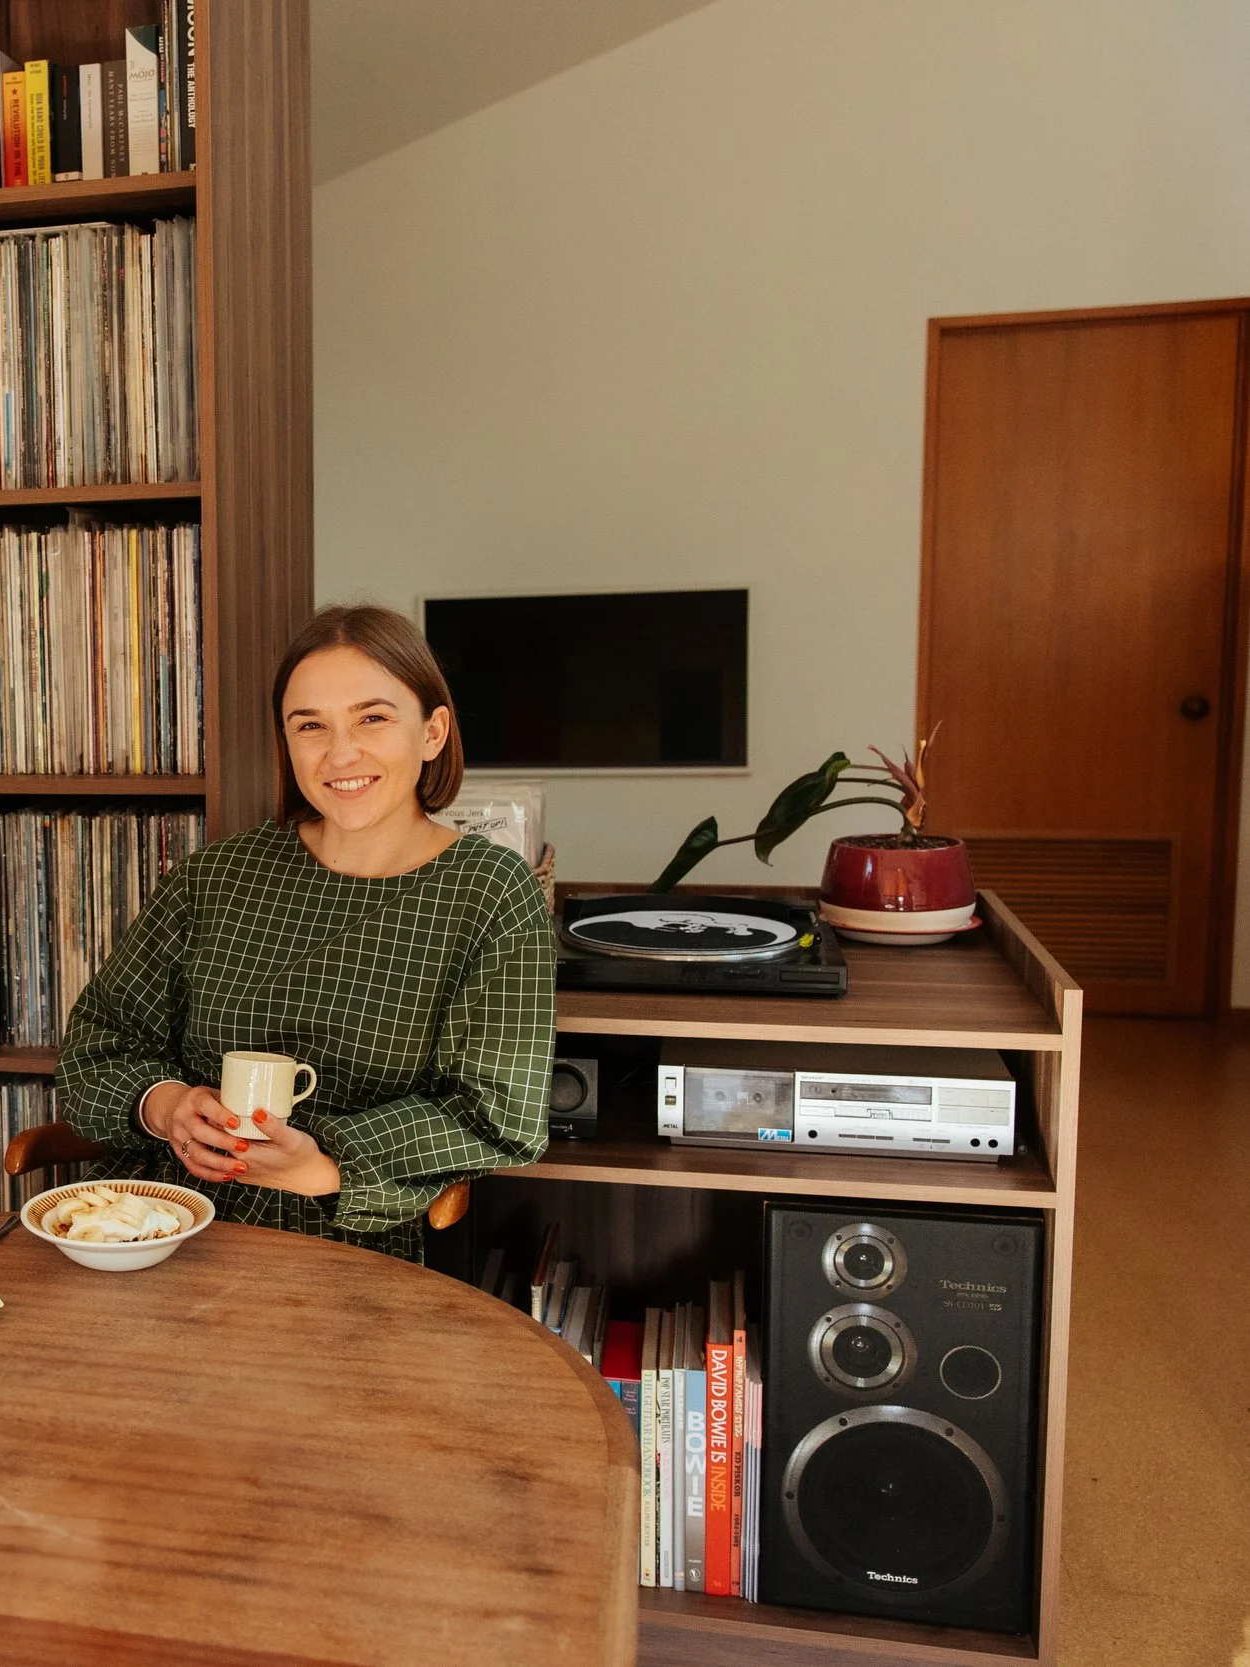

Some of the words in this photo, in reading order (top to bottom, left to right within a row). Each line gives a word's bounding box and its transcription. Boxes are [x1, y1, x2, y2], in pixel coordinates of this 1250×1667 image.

[128, 69, 155, 79] MOJO
[187, 62, 196, 79] THE
[108, 99, 116, 127] YEARS
[187, 81, 196, 129] ANTHOLOGY
[13, 99, 22, 148] REVOLUTION
[36, 125, 45, 144] COULD
[117, 110, 125, 162] McCARTNEY
[466, 808, 485, 817] Jerk
[939, 1279, 1008, 1293] Technics
[643, 1373, 653, 1394] THE
[660, 1377, 671, 1391] POP
[711, 1349, 727, 1397] DAVID
[661, 1392, 671, 1408] STAR
[643, 1396, 653, 1435] GUITAR
[661, 1408, 671, 1444] PORTRAITS
[711, 1399, 727, 1448] BOWIE
[642, 1437, 653, 1497] HANDBOOK
[685, 1410, 706, 1517] BOWIE
[710, 1450, 727, 1463] IS
[734, 1451, 741, 1463] ED
[710, 1466, 726, 1512] INSIDE
[867, 1571, 919, 1585] Technics
